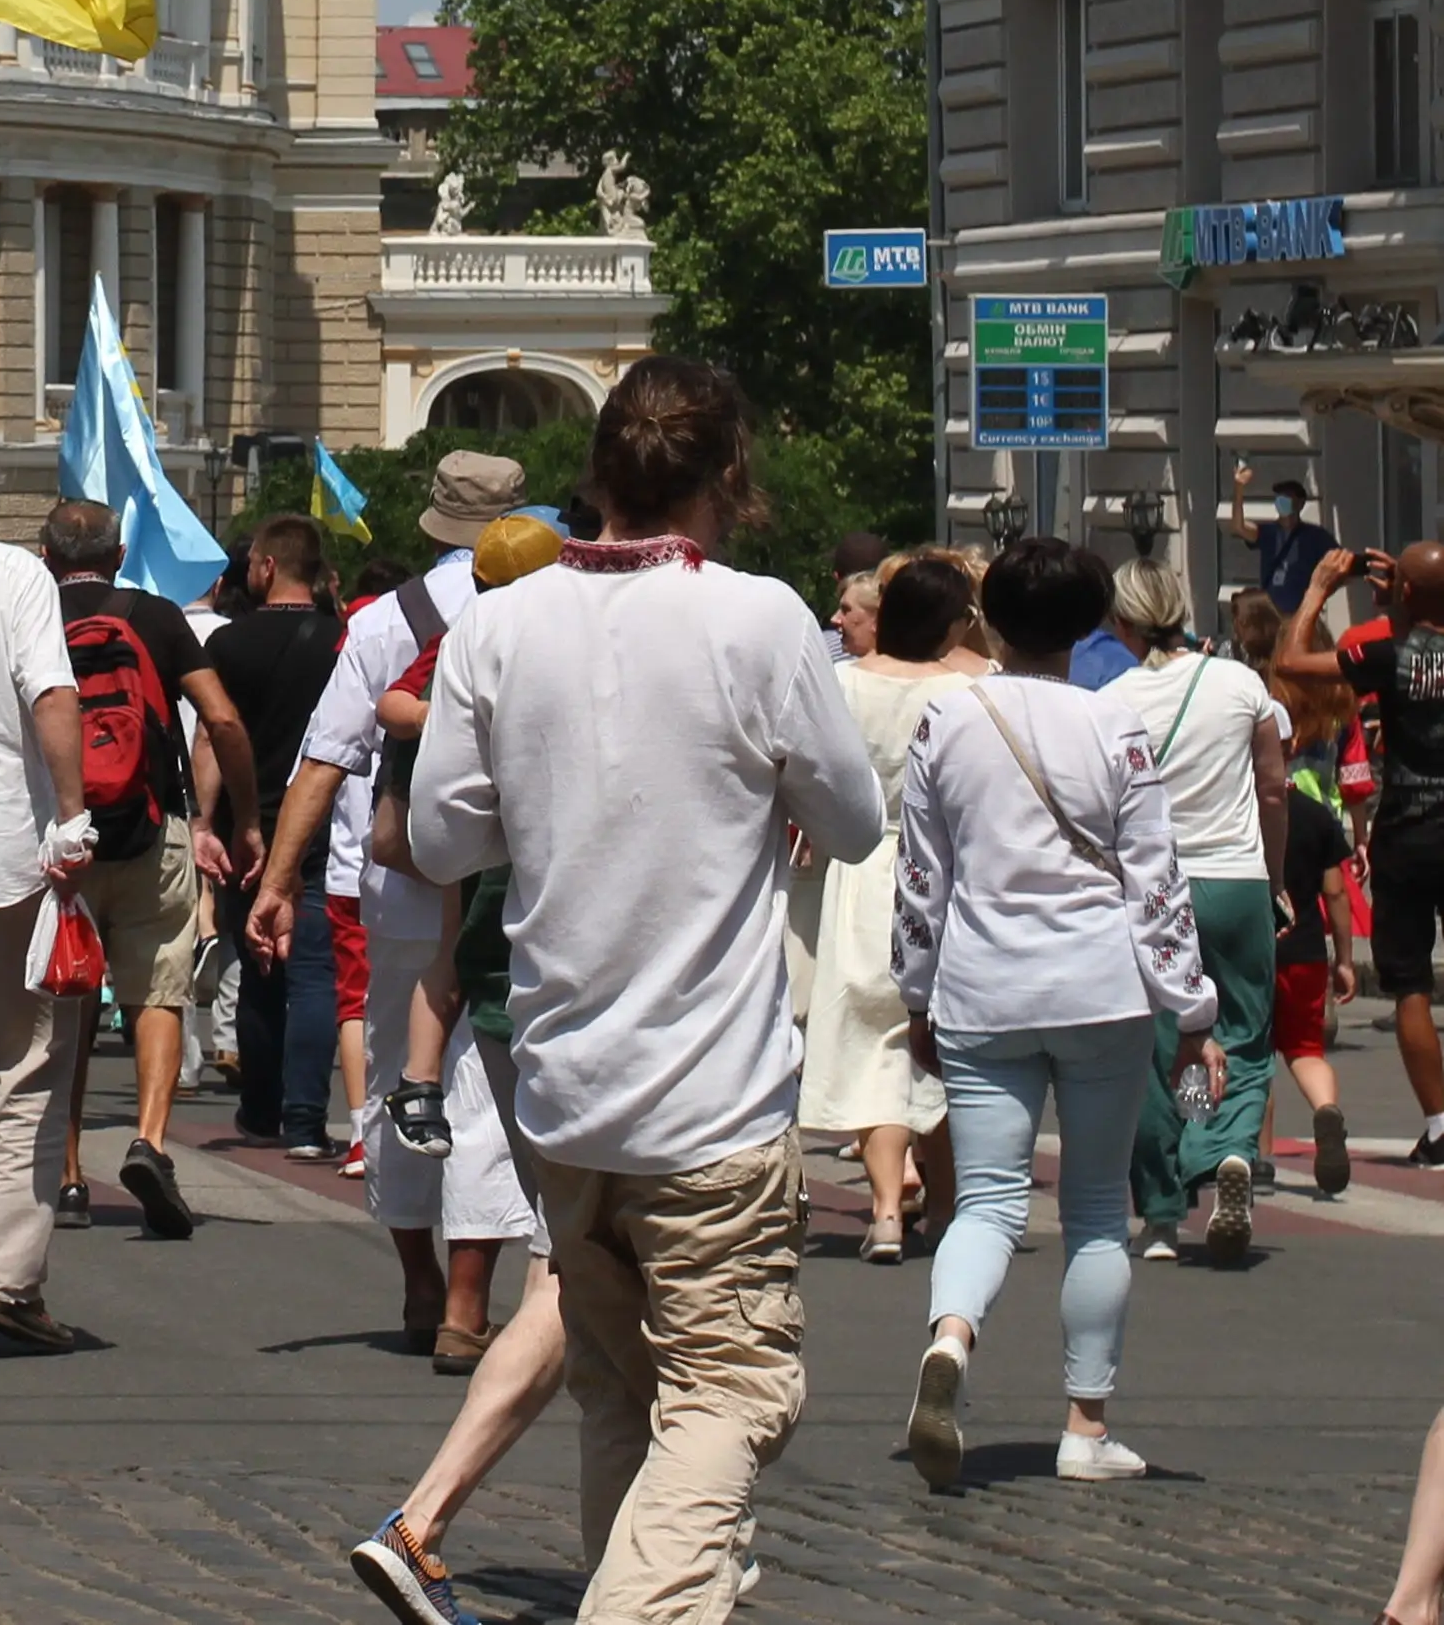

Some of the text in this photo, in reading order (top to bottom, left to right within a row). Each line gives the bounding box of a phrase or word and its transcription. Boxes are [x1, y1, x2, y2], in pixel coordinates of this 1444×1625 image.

[1193, 195, 1337, 266] MTB BANK
[873, 246, 921, 264] MTB
[874, 263, 920, 272] BANK
[1009, 302, 1089, 314] MTB BANK
[1014, 323, 1066, 335] ОБМІН
[1014, 336, 1065, 347] ВАЛЮТ
[1033, 371, 1049, 387] 1$
[1033, 393, 1049, 408] 1€
[979, 432, 1102, 446] Currency exchange
